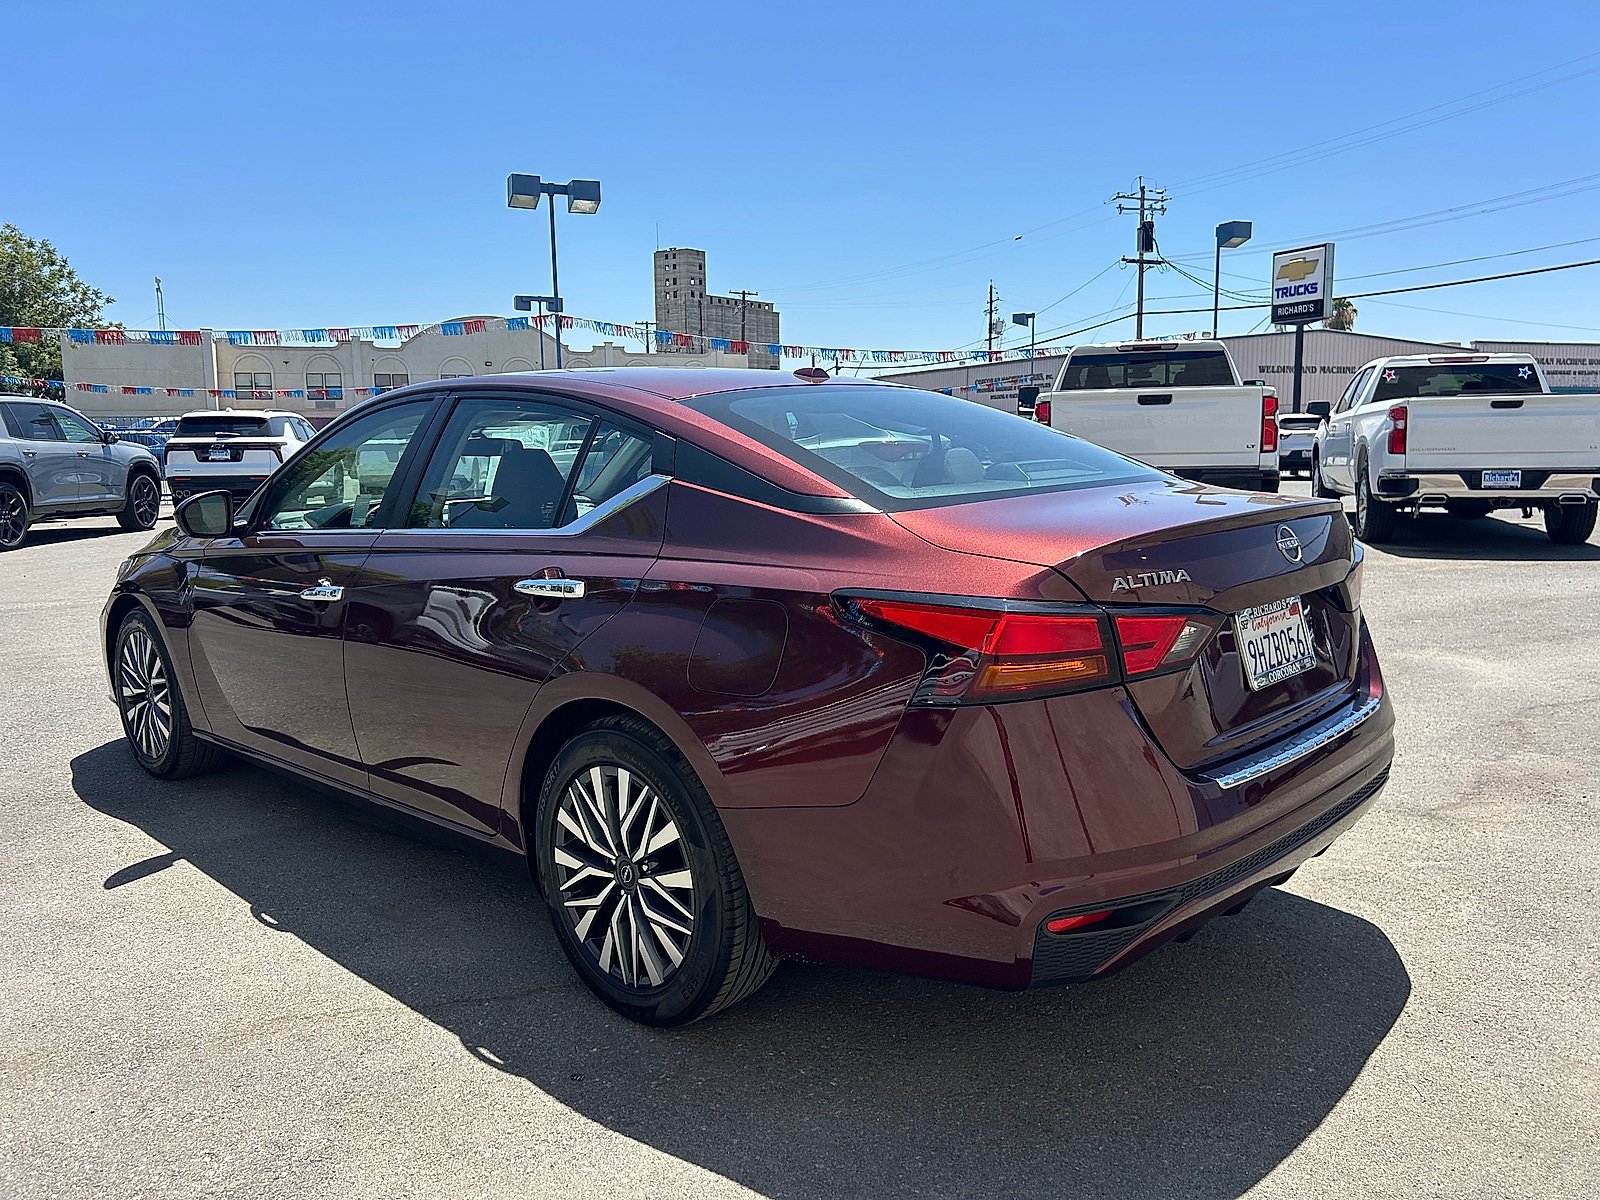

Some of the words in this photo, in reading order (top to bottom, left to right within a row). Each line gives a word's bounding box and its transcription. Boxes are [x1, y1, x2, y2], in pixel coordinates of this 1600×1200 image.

[1274, 282, 1318, 299] TRUCKS
[1277, 303, 1315, 316] RICHARD'S
[1319, 365, 1356, 374] MACHINE
[1484, 474, 1518, 482] Richard's
[1111, 569, 1192, 593] ALTIMA
[1247, 623, 1307, 677] 9HZB056
[1268, 662, 1301, 683] CORCORAN
